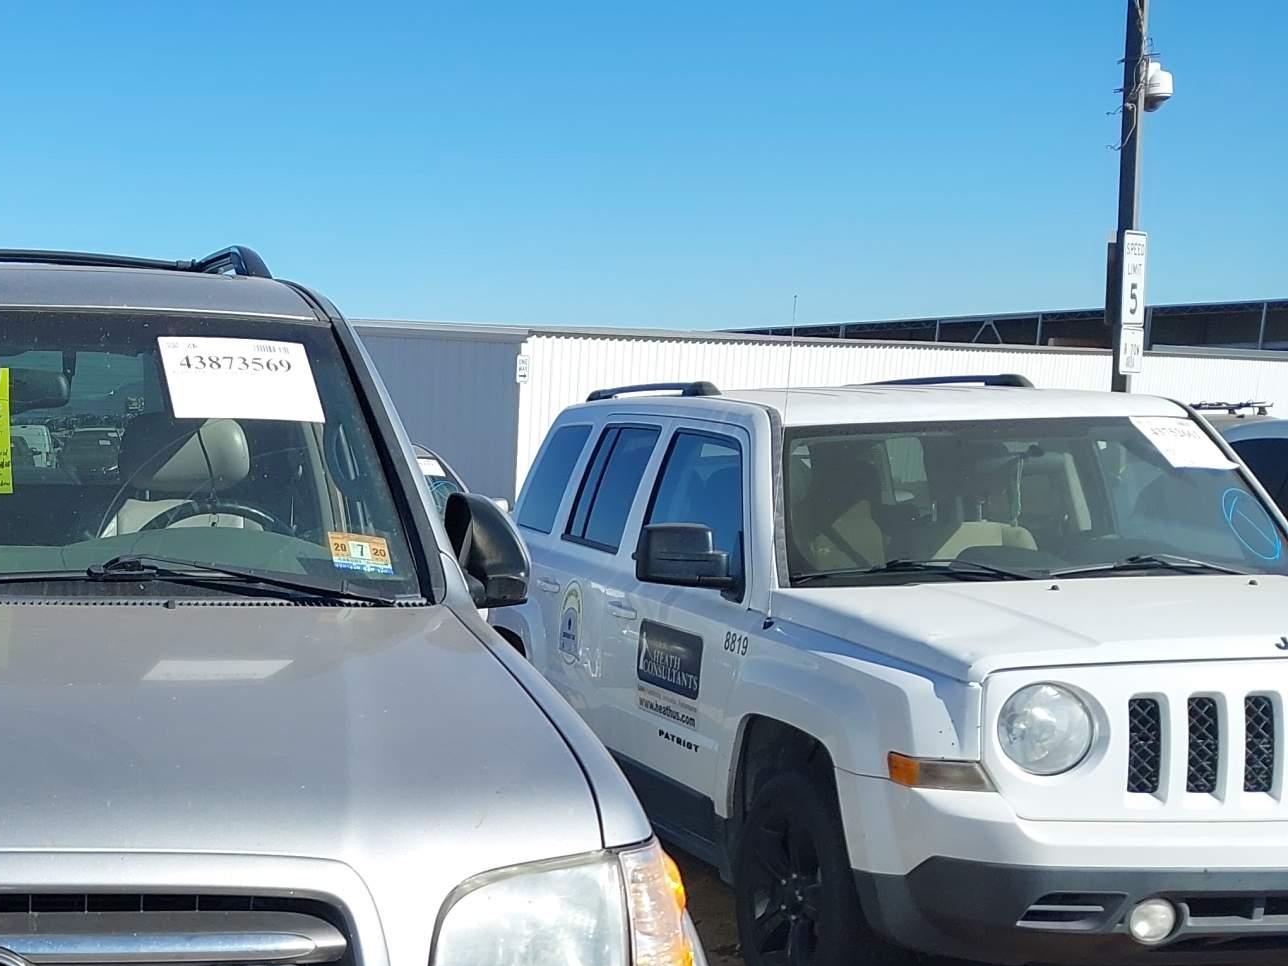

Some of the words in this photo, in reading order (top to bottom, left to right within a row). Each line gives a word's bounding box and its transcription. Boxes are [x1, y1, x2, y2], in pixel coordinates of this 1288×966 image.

[1126, 242, 1145, 256] SPEED
[1127, 263, 1143, 276] LIMIT
[1129, 282, 1138, 315] 5
[179, 354, 292, 373] 43873569
[357, 544, 364, 557] 7
[372, 548, 386, 557] 20
[724, 631, 749, 656] 8819
[653, 648, 681, 671] HEATH
[643, 658, 698, 692] CONSULTANTS
[638, 697, 696, 728] www.heathus.com
[658, 729, 700, 752] PATRIOT
